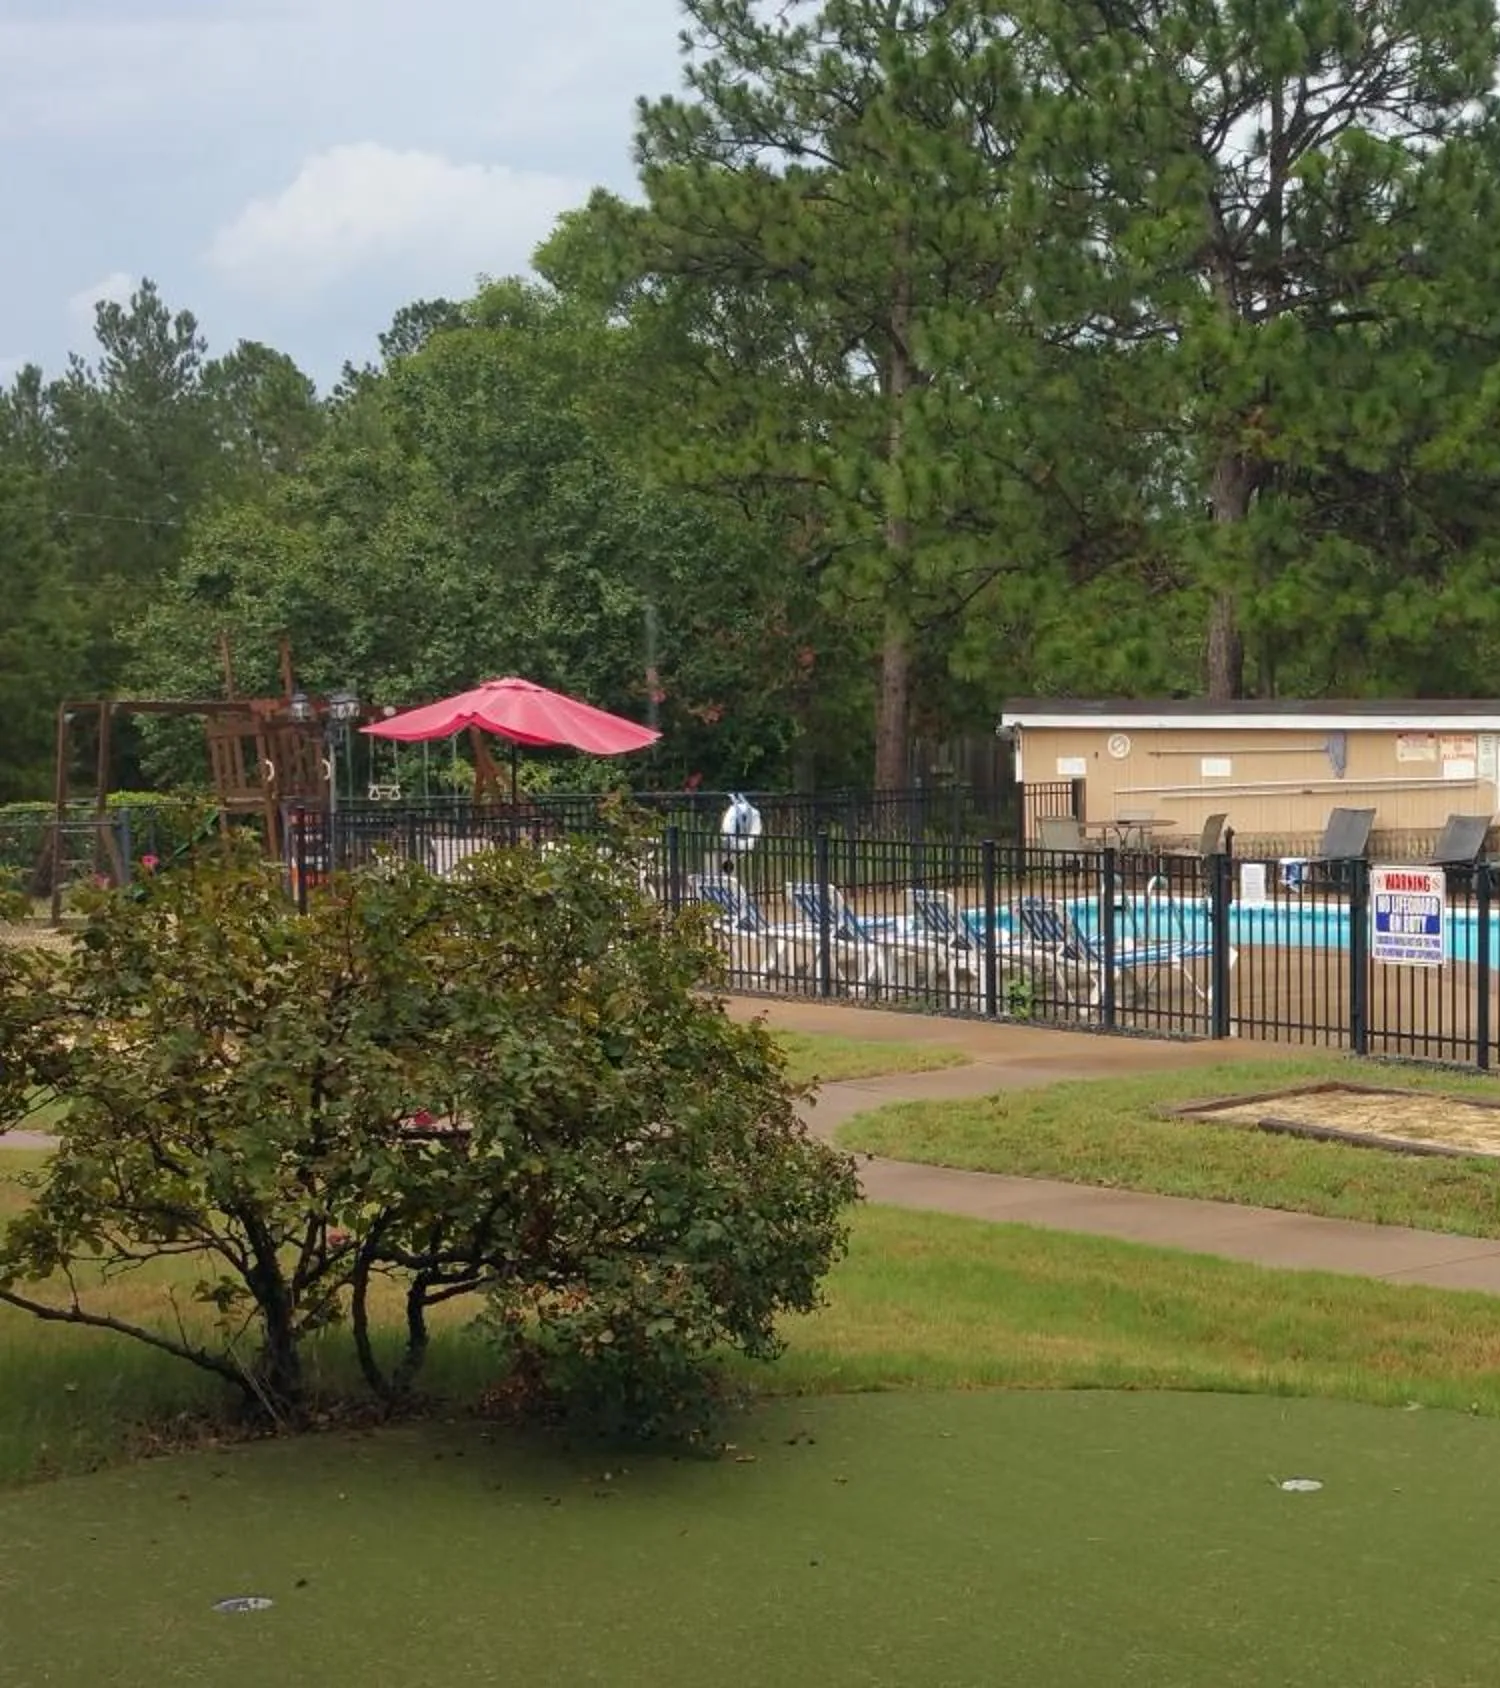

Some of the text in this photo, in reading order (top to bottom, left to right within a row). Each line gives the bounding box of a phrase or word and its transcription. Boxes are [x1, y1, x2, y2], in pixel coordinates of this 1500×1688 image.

[1384, 873, 1431, 892] WARNING
[1377, 895, 1439, 916] NO LIFEGUARD
[1389, 914, 1427, 933] ON DUTY
